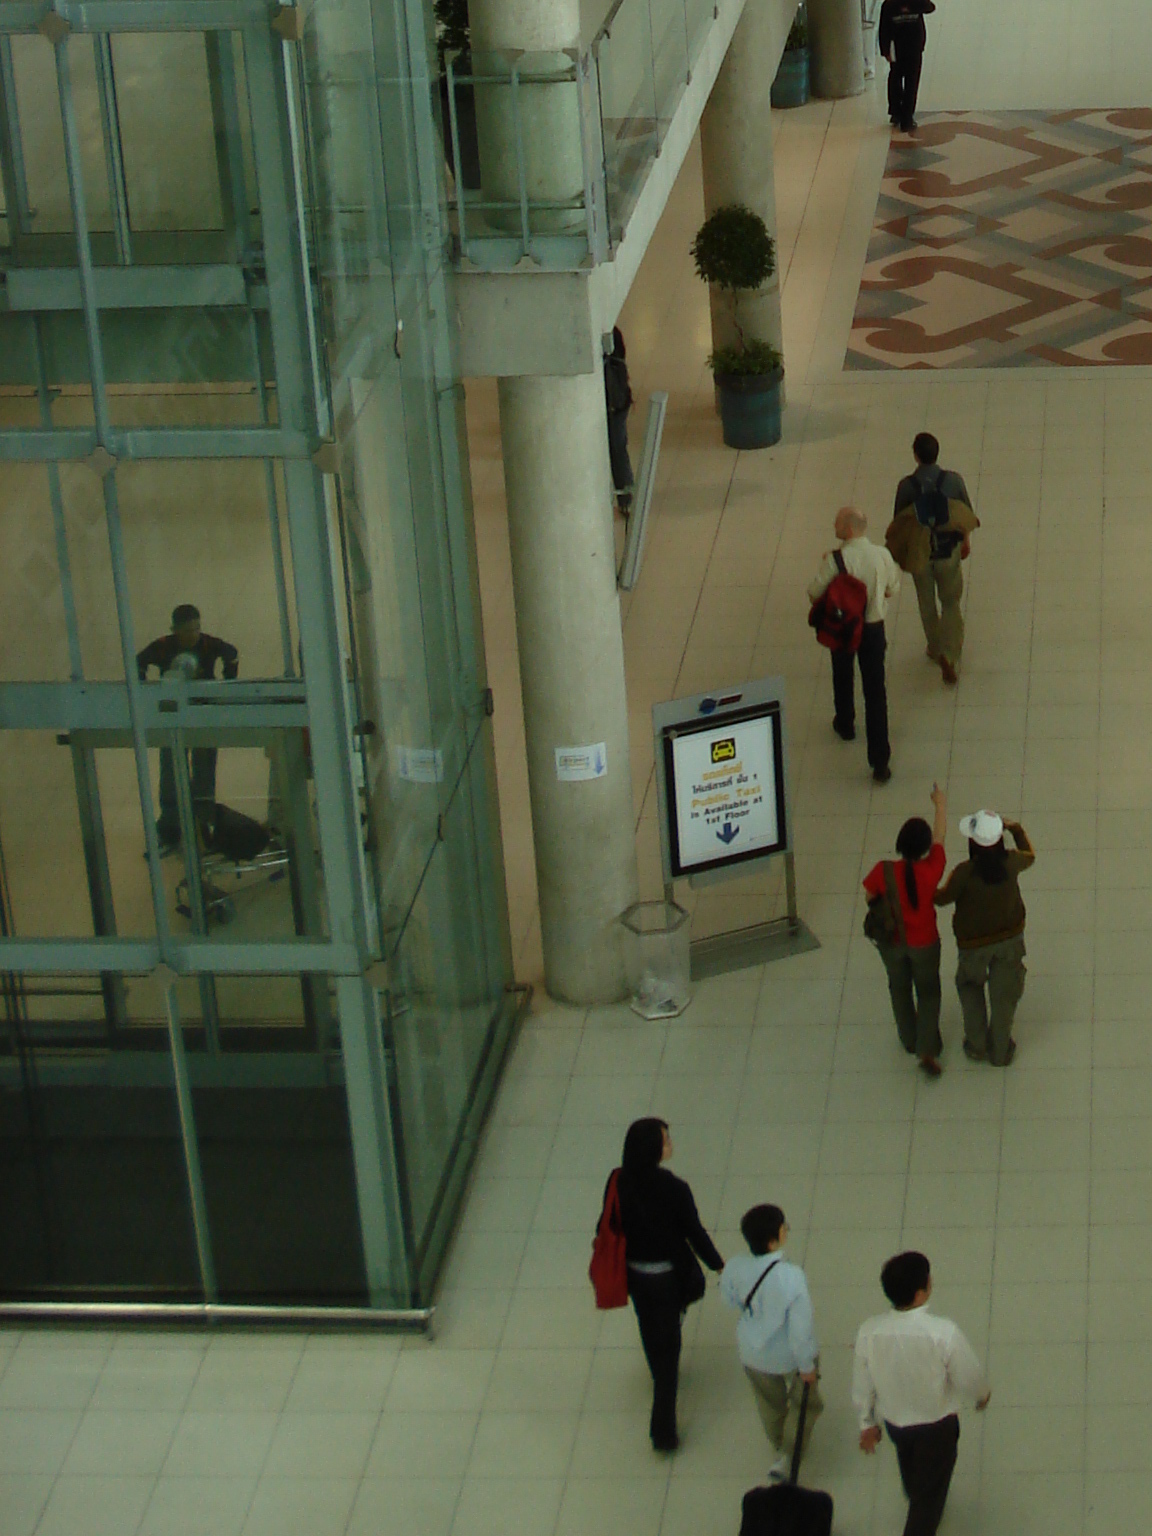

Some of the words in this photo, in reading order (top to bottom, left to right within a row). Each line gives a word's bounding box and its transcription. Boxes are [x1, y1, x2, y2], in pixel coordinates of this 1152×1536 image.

[691, 793, 730, 808] Public
[736, 786, 761, 798] Taxi
[704, 800, 749, 816] Available
[753, 796, 763, 804] at
[706, 815, 720, 825] 1st
[725, 809, 750, 822] Floor
